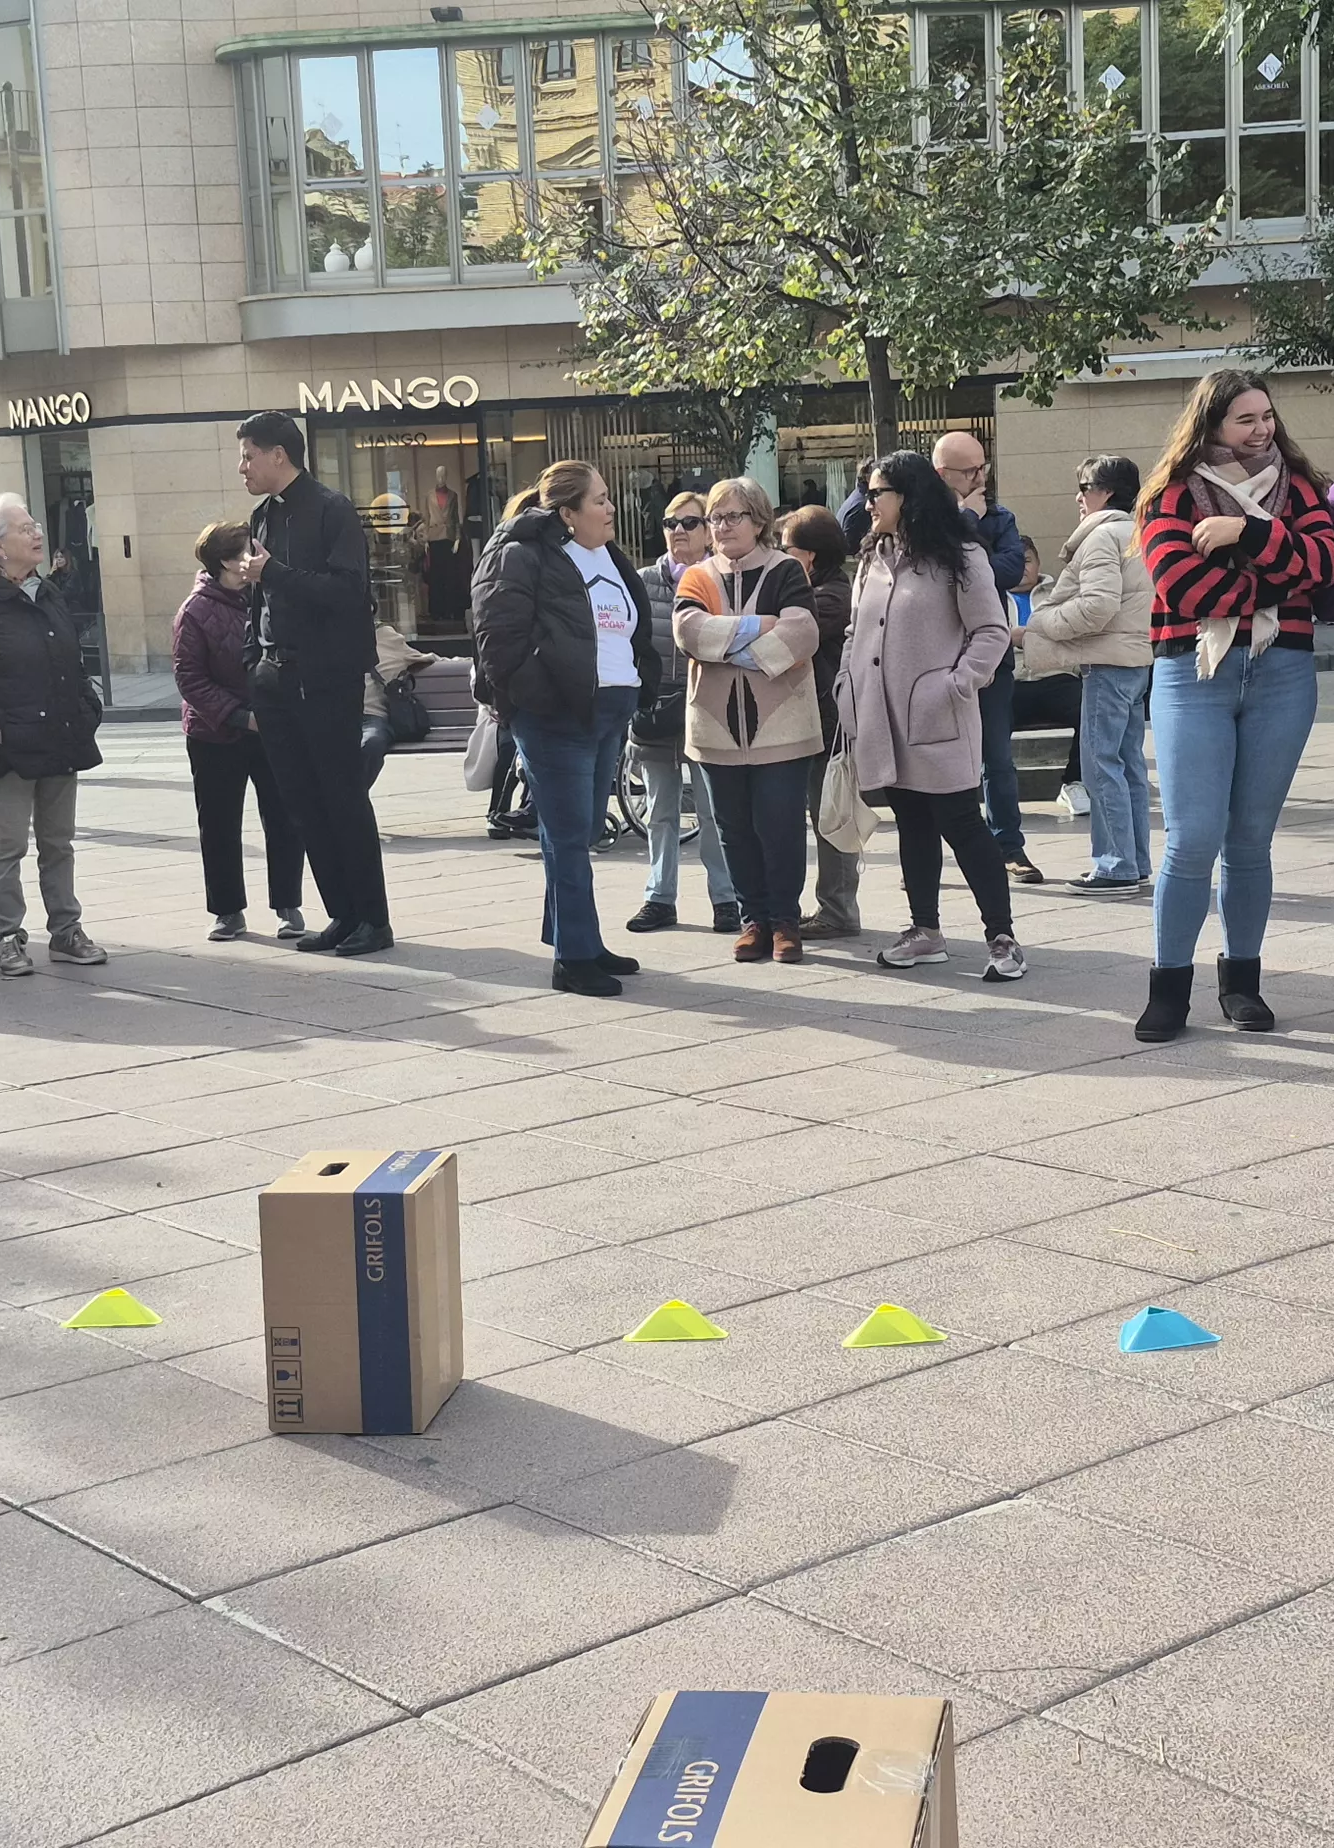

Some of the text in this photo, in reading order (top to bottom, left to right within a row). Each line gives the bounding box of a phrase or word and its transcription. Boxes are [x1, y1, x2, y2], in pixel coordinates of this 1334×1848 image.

[8, 391, 90, 429] MANGO
[298, 375, 479, 413] MANGO
[360, 431, 427, 447] MANGO
[364, 1198, 384, 1282] GRIFOLS
[657, 1760, 720, 1844] GRIFOLS
